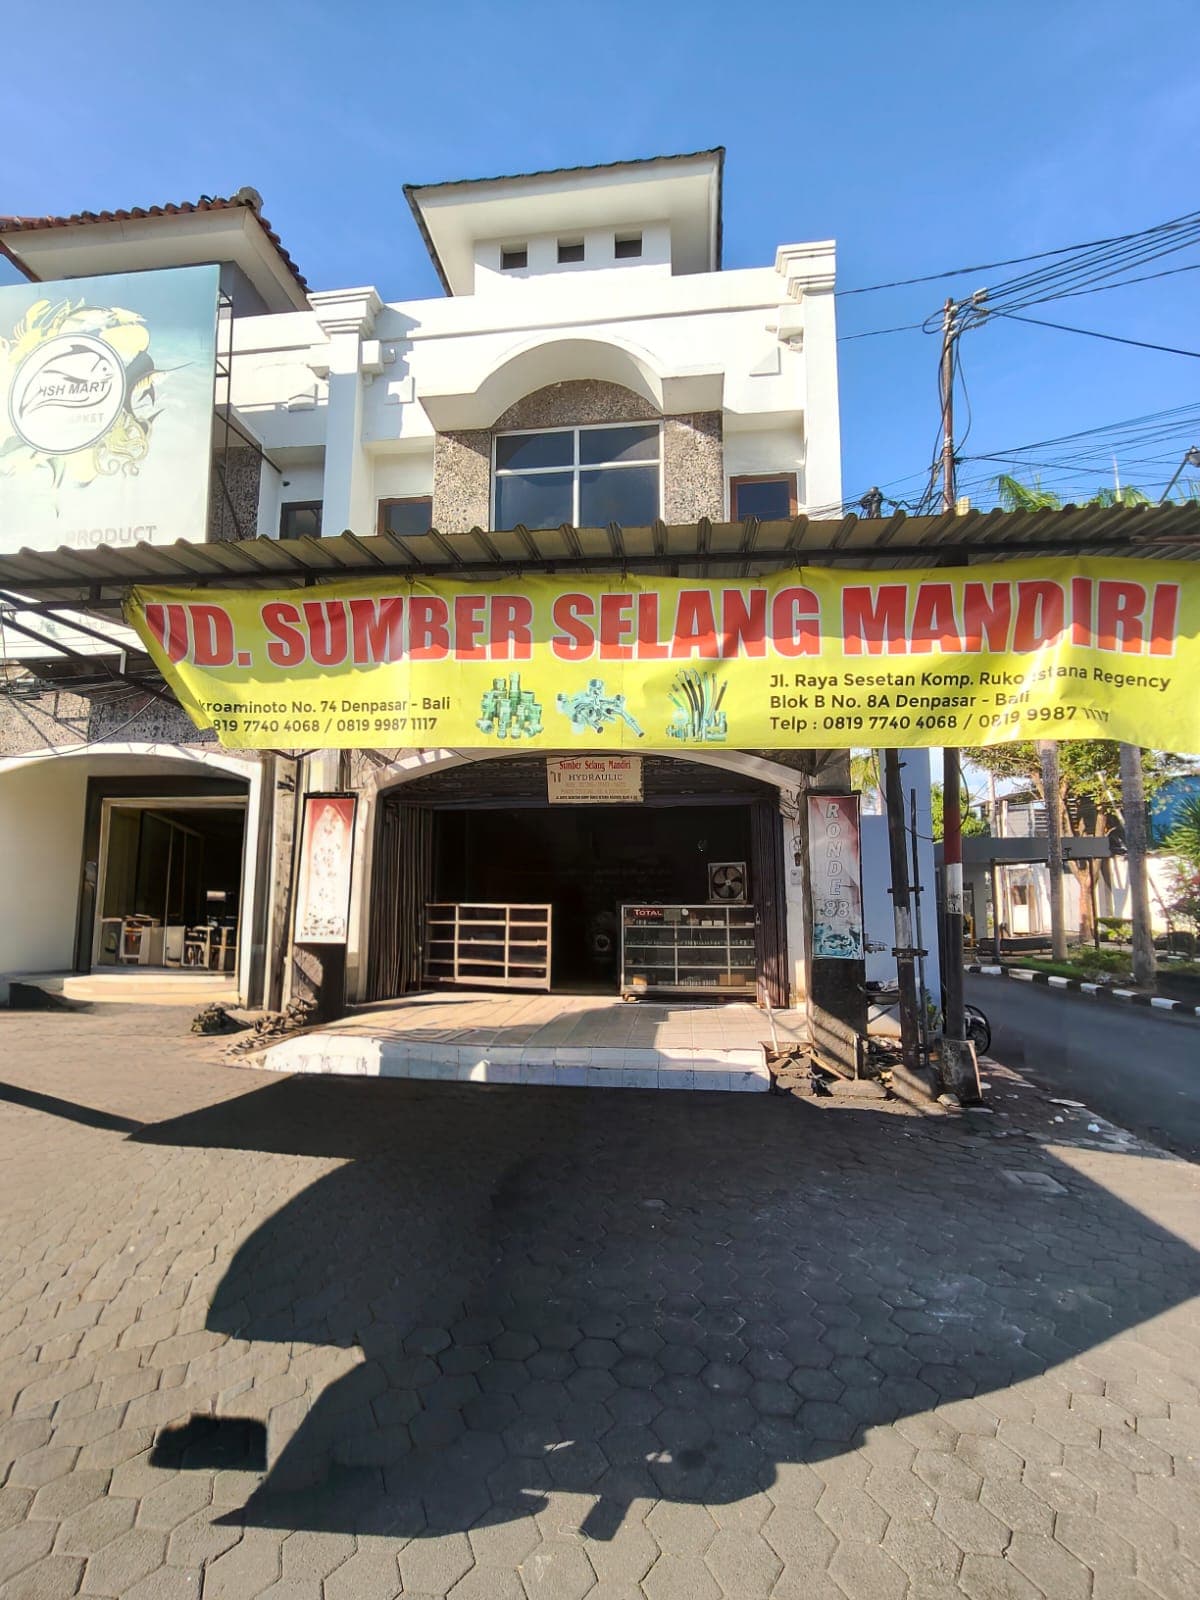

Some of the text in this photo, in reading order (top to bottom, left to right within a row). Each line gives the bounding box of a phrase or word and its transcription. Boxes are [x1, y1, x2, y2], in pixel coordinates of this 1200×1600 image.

[68, 380, 109, 394] MART
[65, 525, 157, 545] PRODUCT
[145, 577, 1179, 668] UD. SUMBER SELANG MANDIRI
[769, 674, 789, 687] Jl.
[795, 674, 838, 690] Raya
[844, 672, 915, 687] Sesetan
[921, 672, 974, 689] Komp.
[979, 671, 1025, 685] Ruko
[1093, 668, 1171, 692] Regency
[291, 701, 316, 713] No.
[320, 701, 337, 712] 74
[341, 700, 407, 715] Denpasar
[422, 696, 451, 710] Bali
[770, 694, 808, 708] Blok
[815, 695, 825, 708] B
[831, 695, 861, 708] No.
[867, 694, 890, 708] 8A
[895, 694, 976, 711] Denpasar
[243, 720, 279, 732] 7740
[283, 720, 320, 732] 4068
[324, 718, 333, 733] /
[337, 719, 370, 732] 0819
[374, 718, 407, 731] 9987
[411, 717, 438, 730] 1117
[769, 716, 808, 733] Telp
[823, 716, 863, 730] 0819
[869, 716, 910, 729] 7740
[916, 715, 957, 729] 4068
[963, 713, 973, 730] /
[979, 711, 1020, 728] 0819
[1027, 706, 1077, 721] 9987
[584, 760, 606, 772] Selang
[568, 773, 624, 781] HYDRAULIC
[824, 803, 850, 918] RONDE 88
